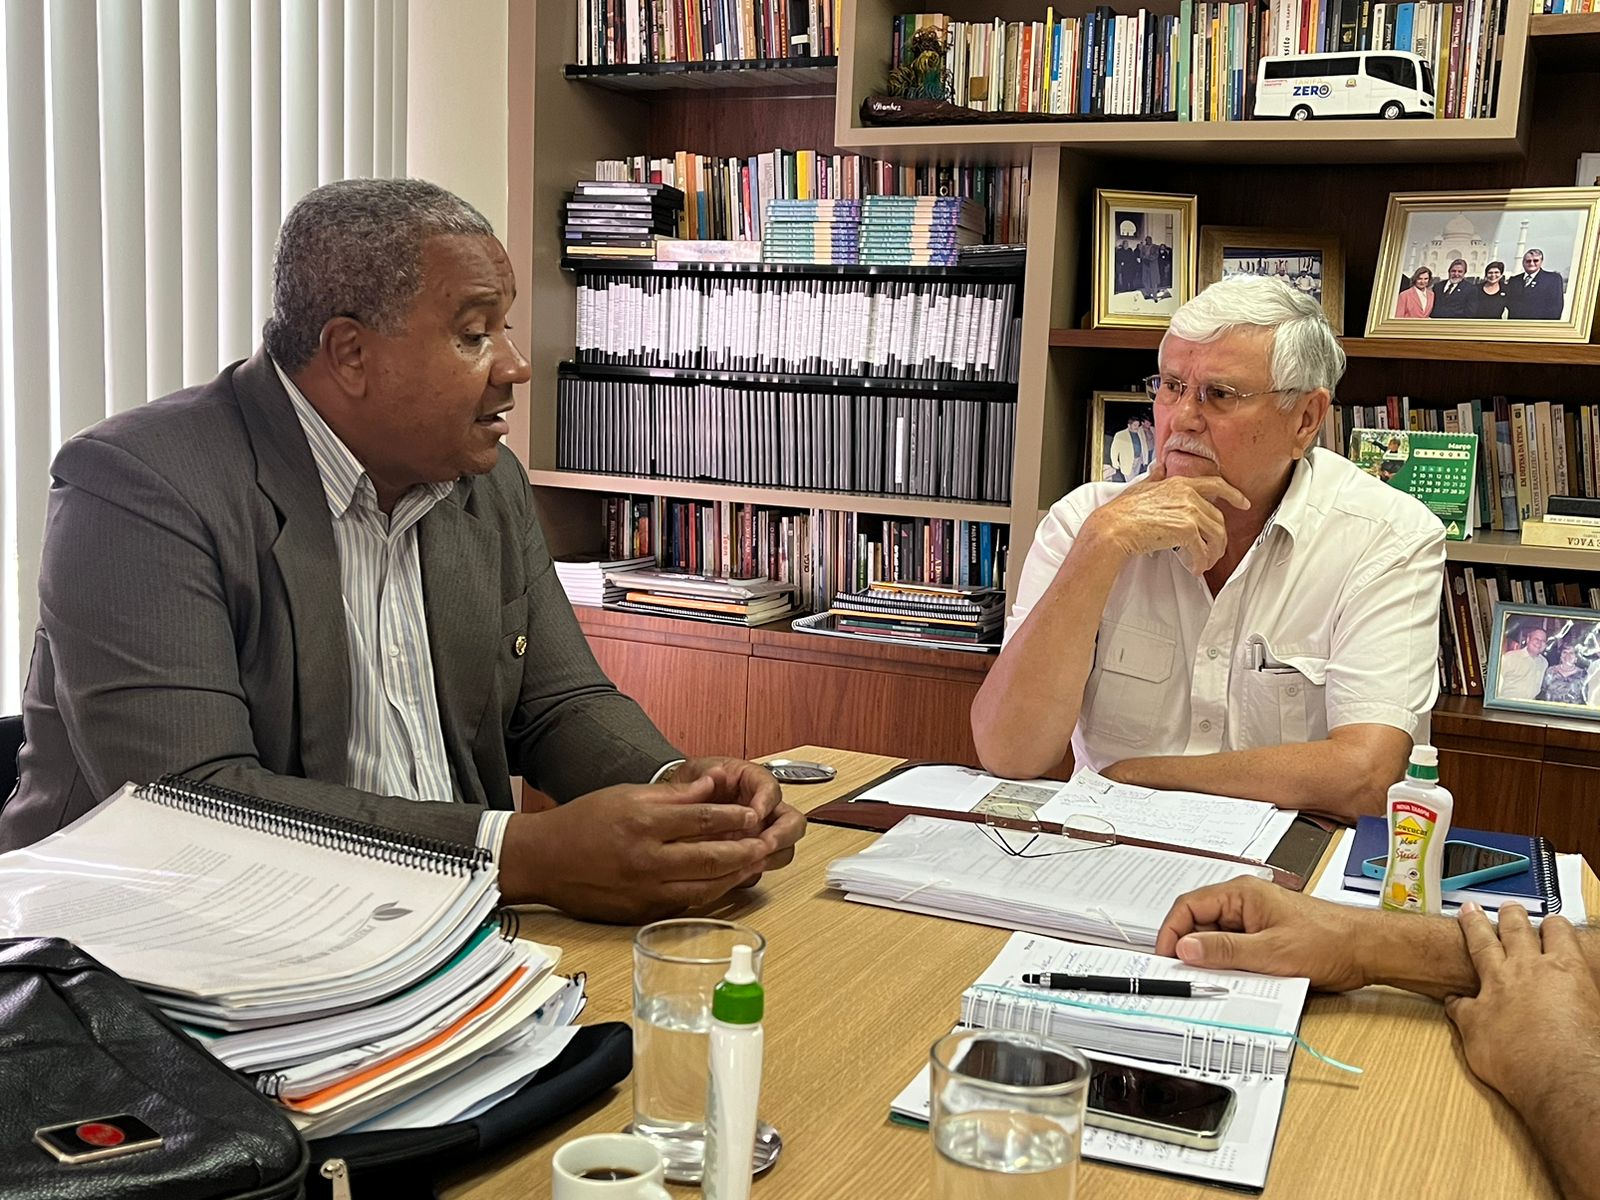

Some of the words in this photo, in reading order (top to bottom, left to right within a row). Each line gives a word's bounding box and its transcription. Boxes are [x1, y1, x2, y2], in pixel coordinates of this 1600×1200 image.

[1293, 85, 1331, 98] ZERO
[1518, 444, 1523, 453] DA
[1567, 537, 1594, 546] VACA
[1411, 805, 1430, 817] TAMPA
